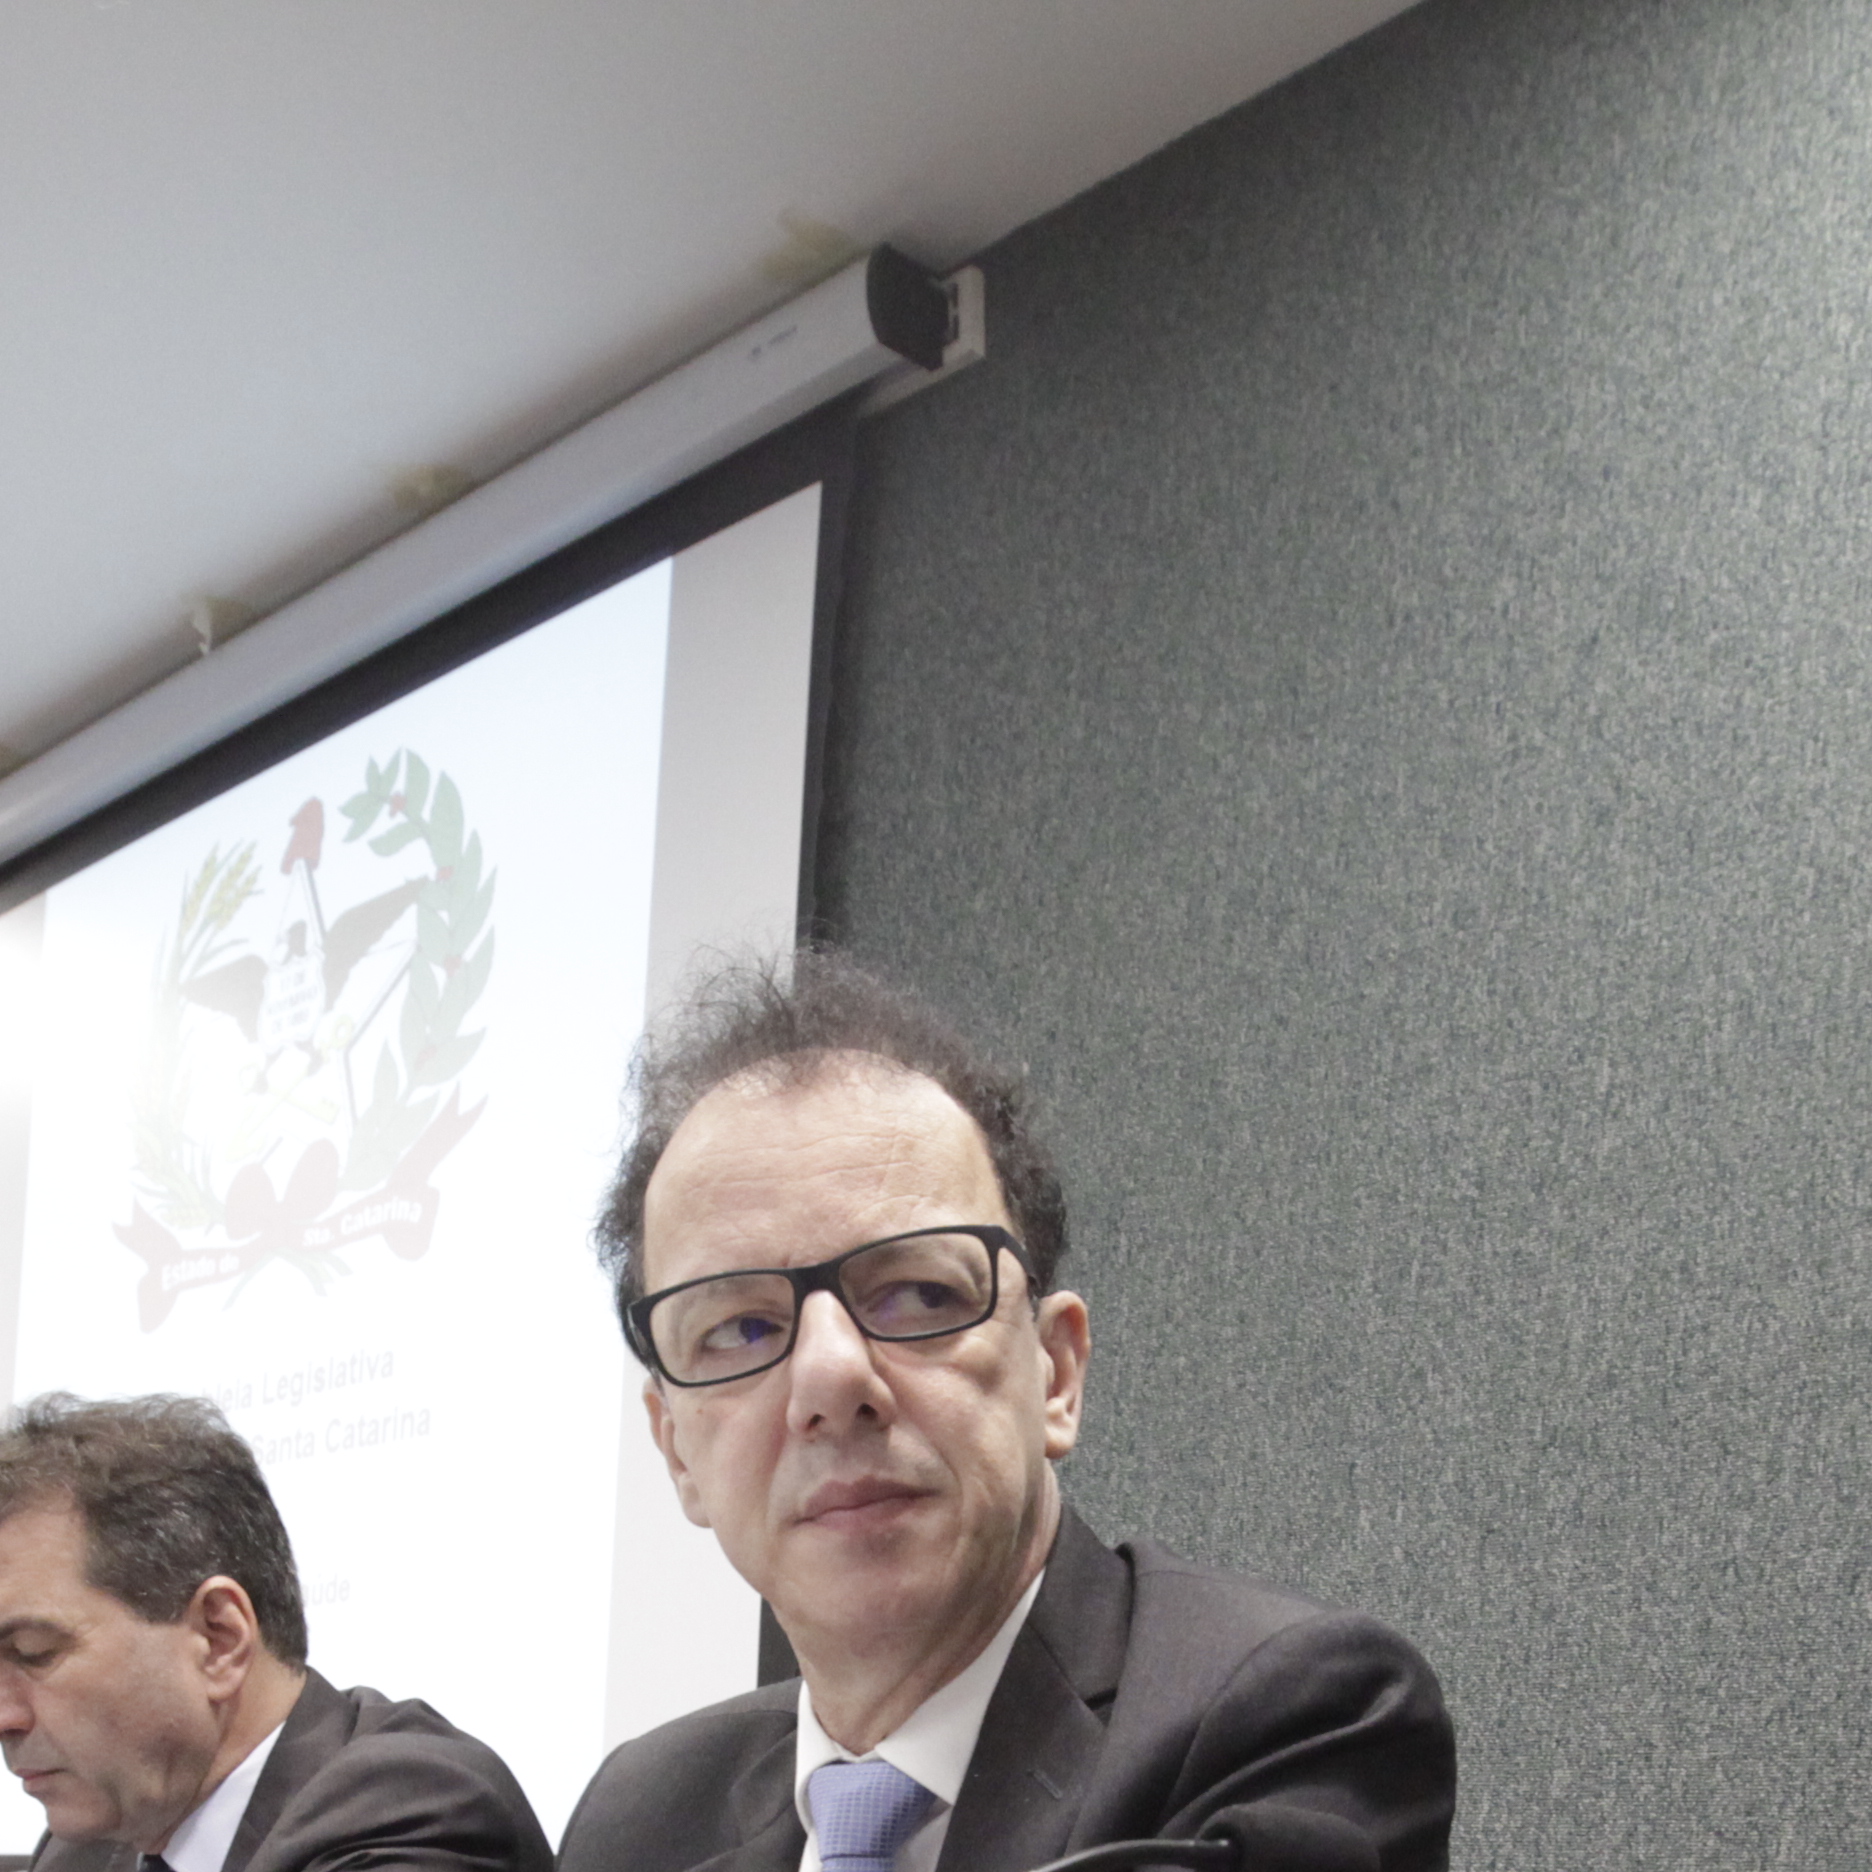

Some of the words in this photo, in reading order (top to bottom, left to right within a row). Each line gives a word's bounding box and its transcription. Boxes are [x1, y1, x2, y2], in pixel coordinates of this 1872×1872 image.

[162, 1255, 217, 1292] Estado
[219, 1252, 241, 1274] de
[340, 1195, 423, 1235] Catarina
[261, 1347, 394, 1407] Legislativa
[325, 1405, 431, 1452] Catarina
